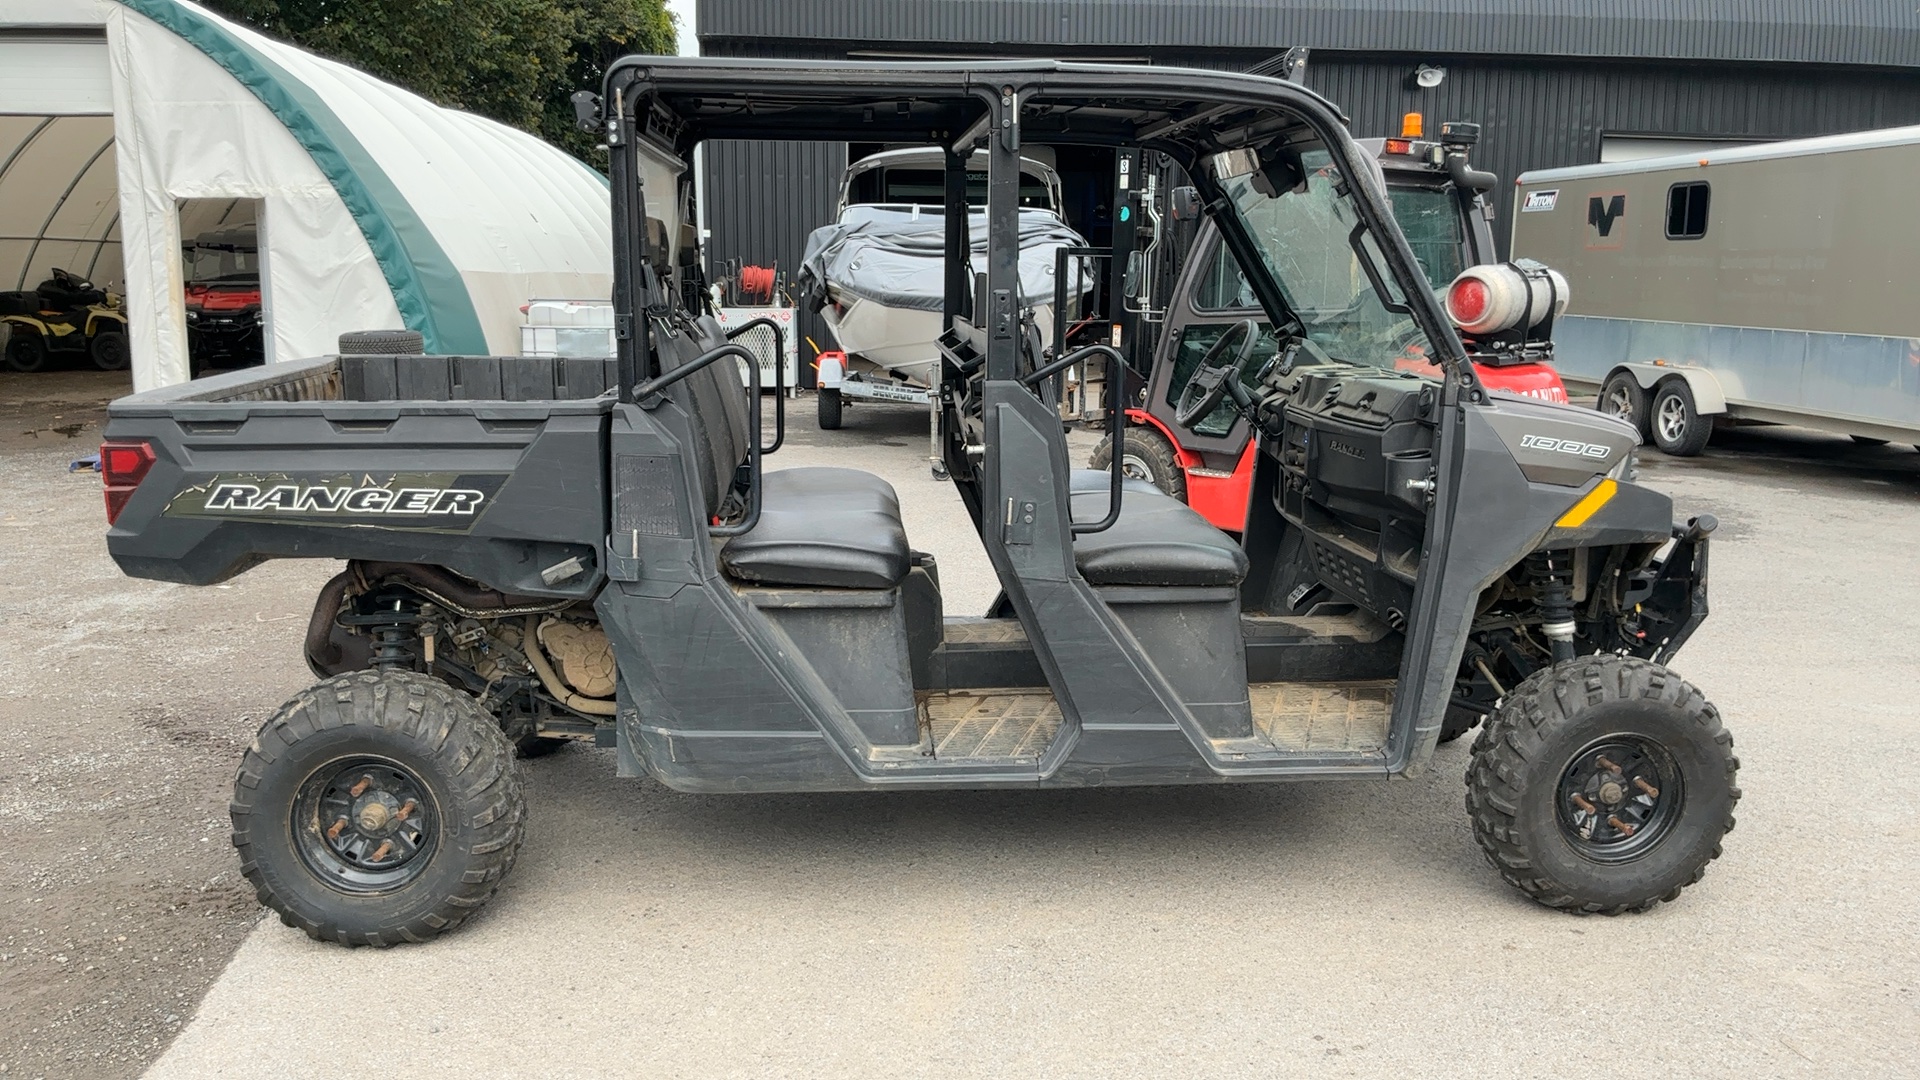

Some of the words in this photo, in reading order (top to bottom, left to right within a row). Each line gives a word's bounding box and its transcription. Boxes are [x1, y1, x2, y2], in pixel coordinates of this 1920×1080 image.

[1527, 193, 1555, 207] TRITON
[1330, 440, 1366, 460] RANGER
[1520, 434, 1610, 458] 1000
[204, 484, 484, 515] RANGER
